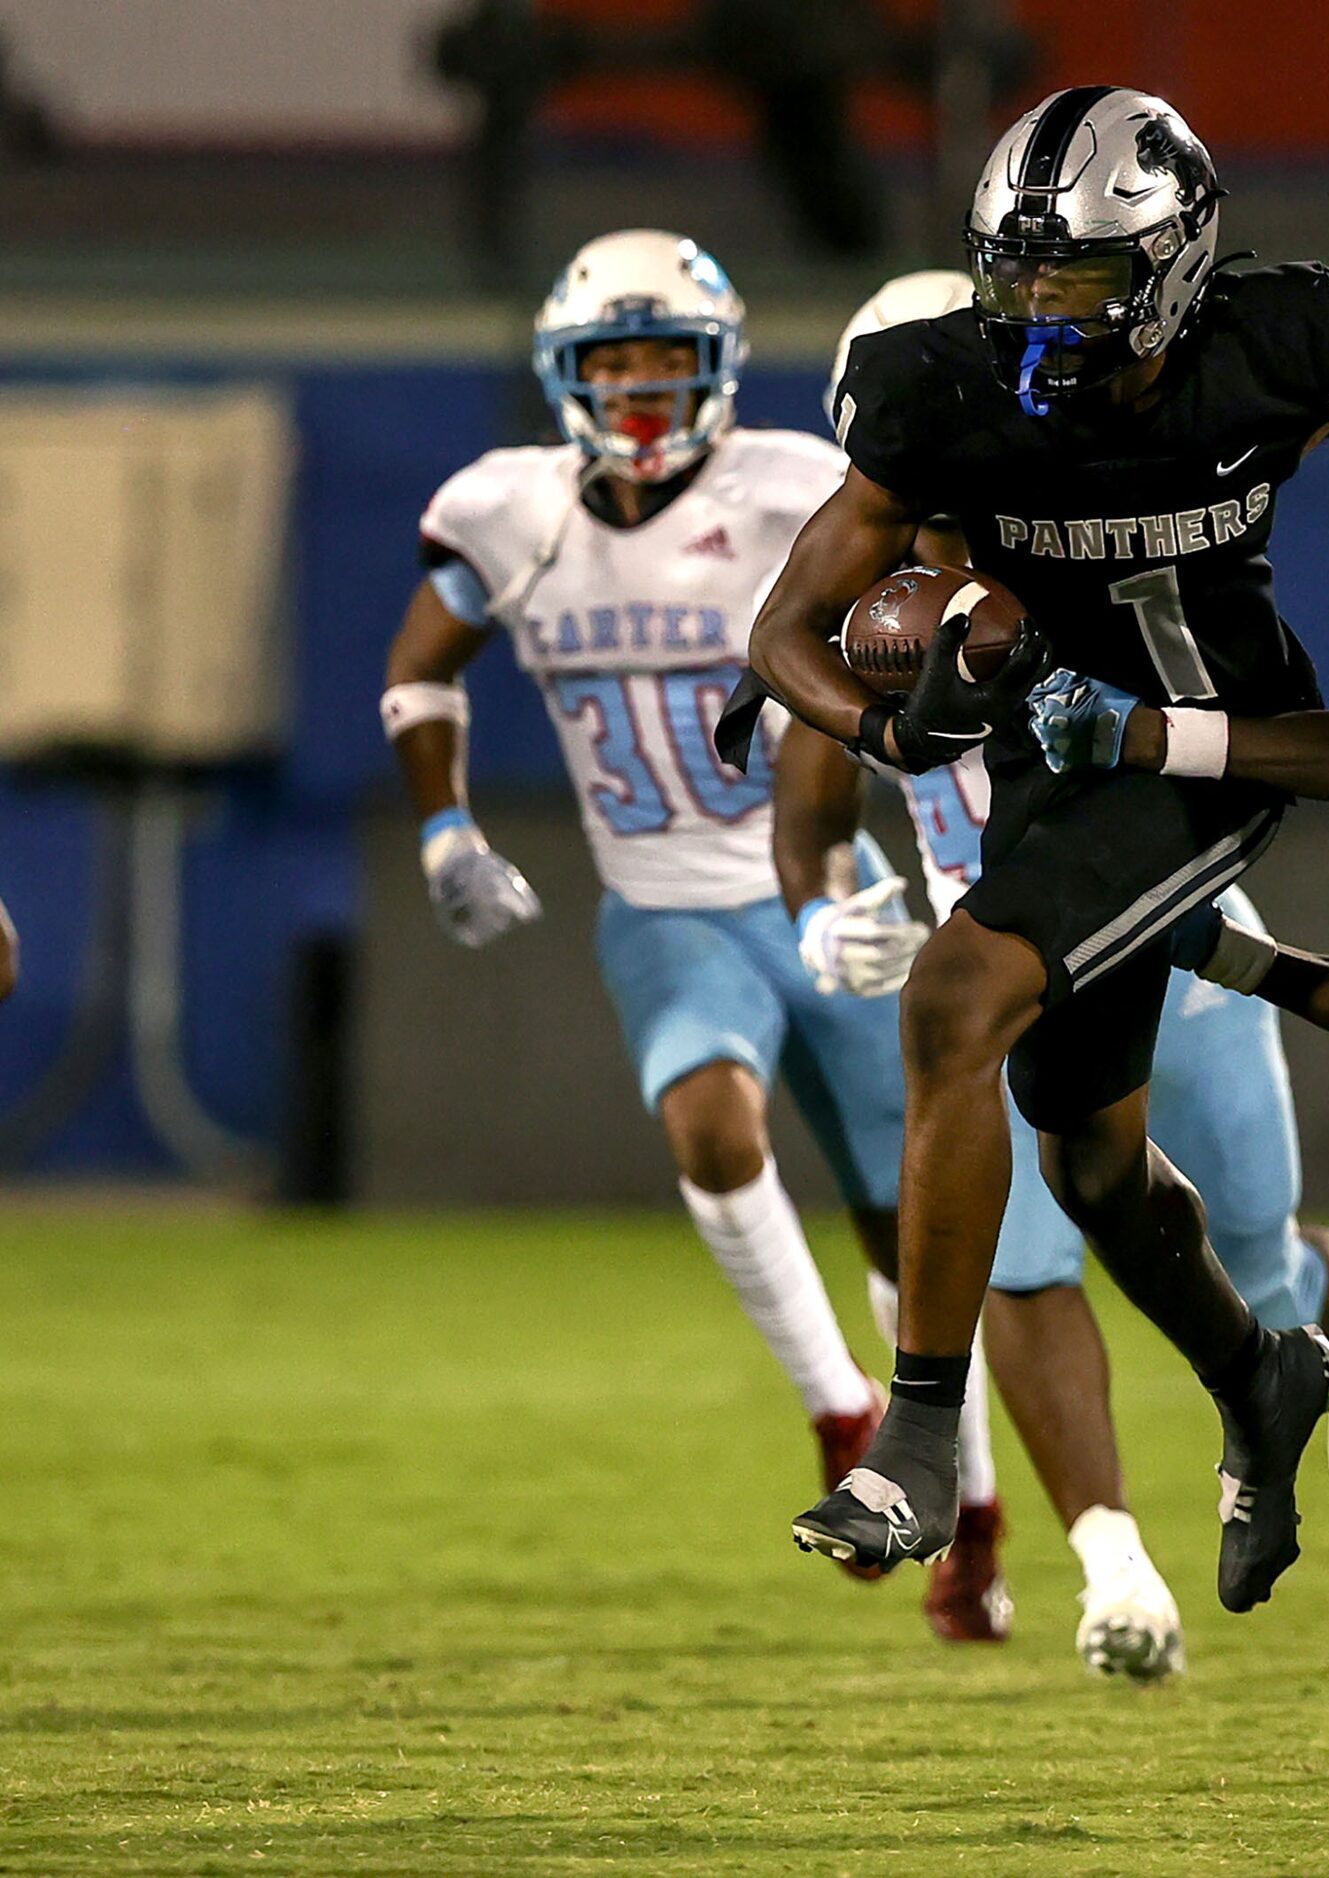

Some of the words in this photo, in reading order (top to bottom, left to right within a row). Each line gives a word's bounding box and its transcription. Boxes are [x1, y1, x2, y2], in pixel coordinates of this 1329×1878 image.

[995, 482, 1270, 560] PANTHERS
[1108, 565, 1219, 703] 1
[546, 657, 776, 836] 30
